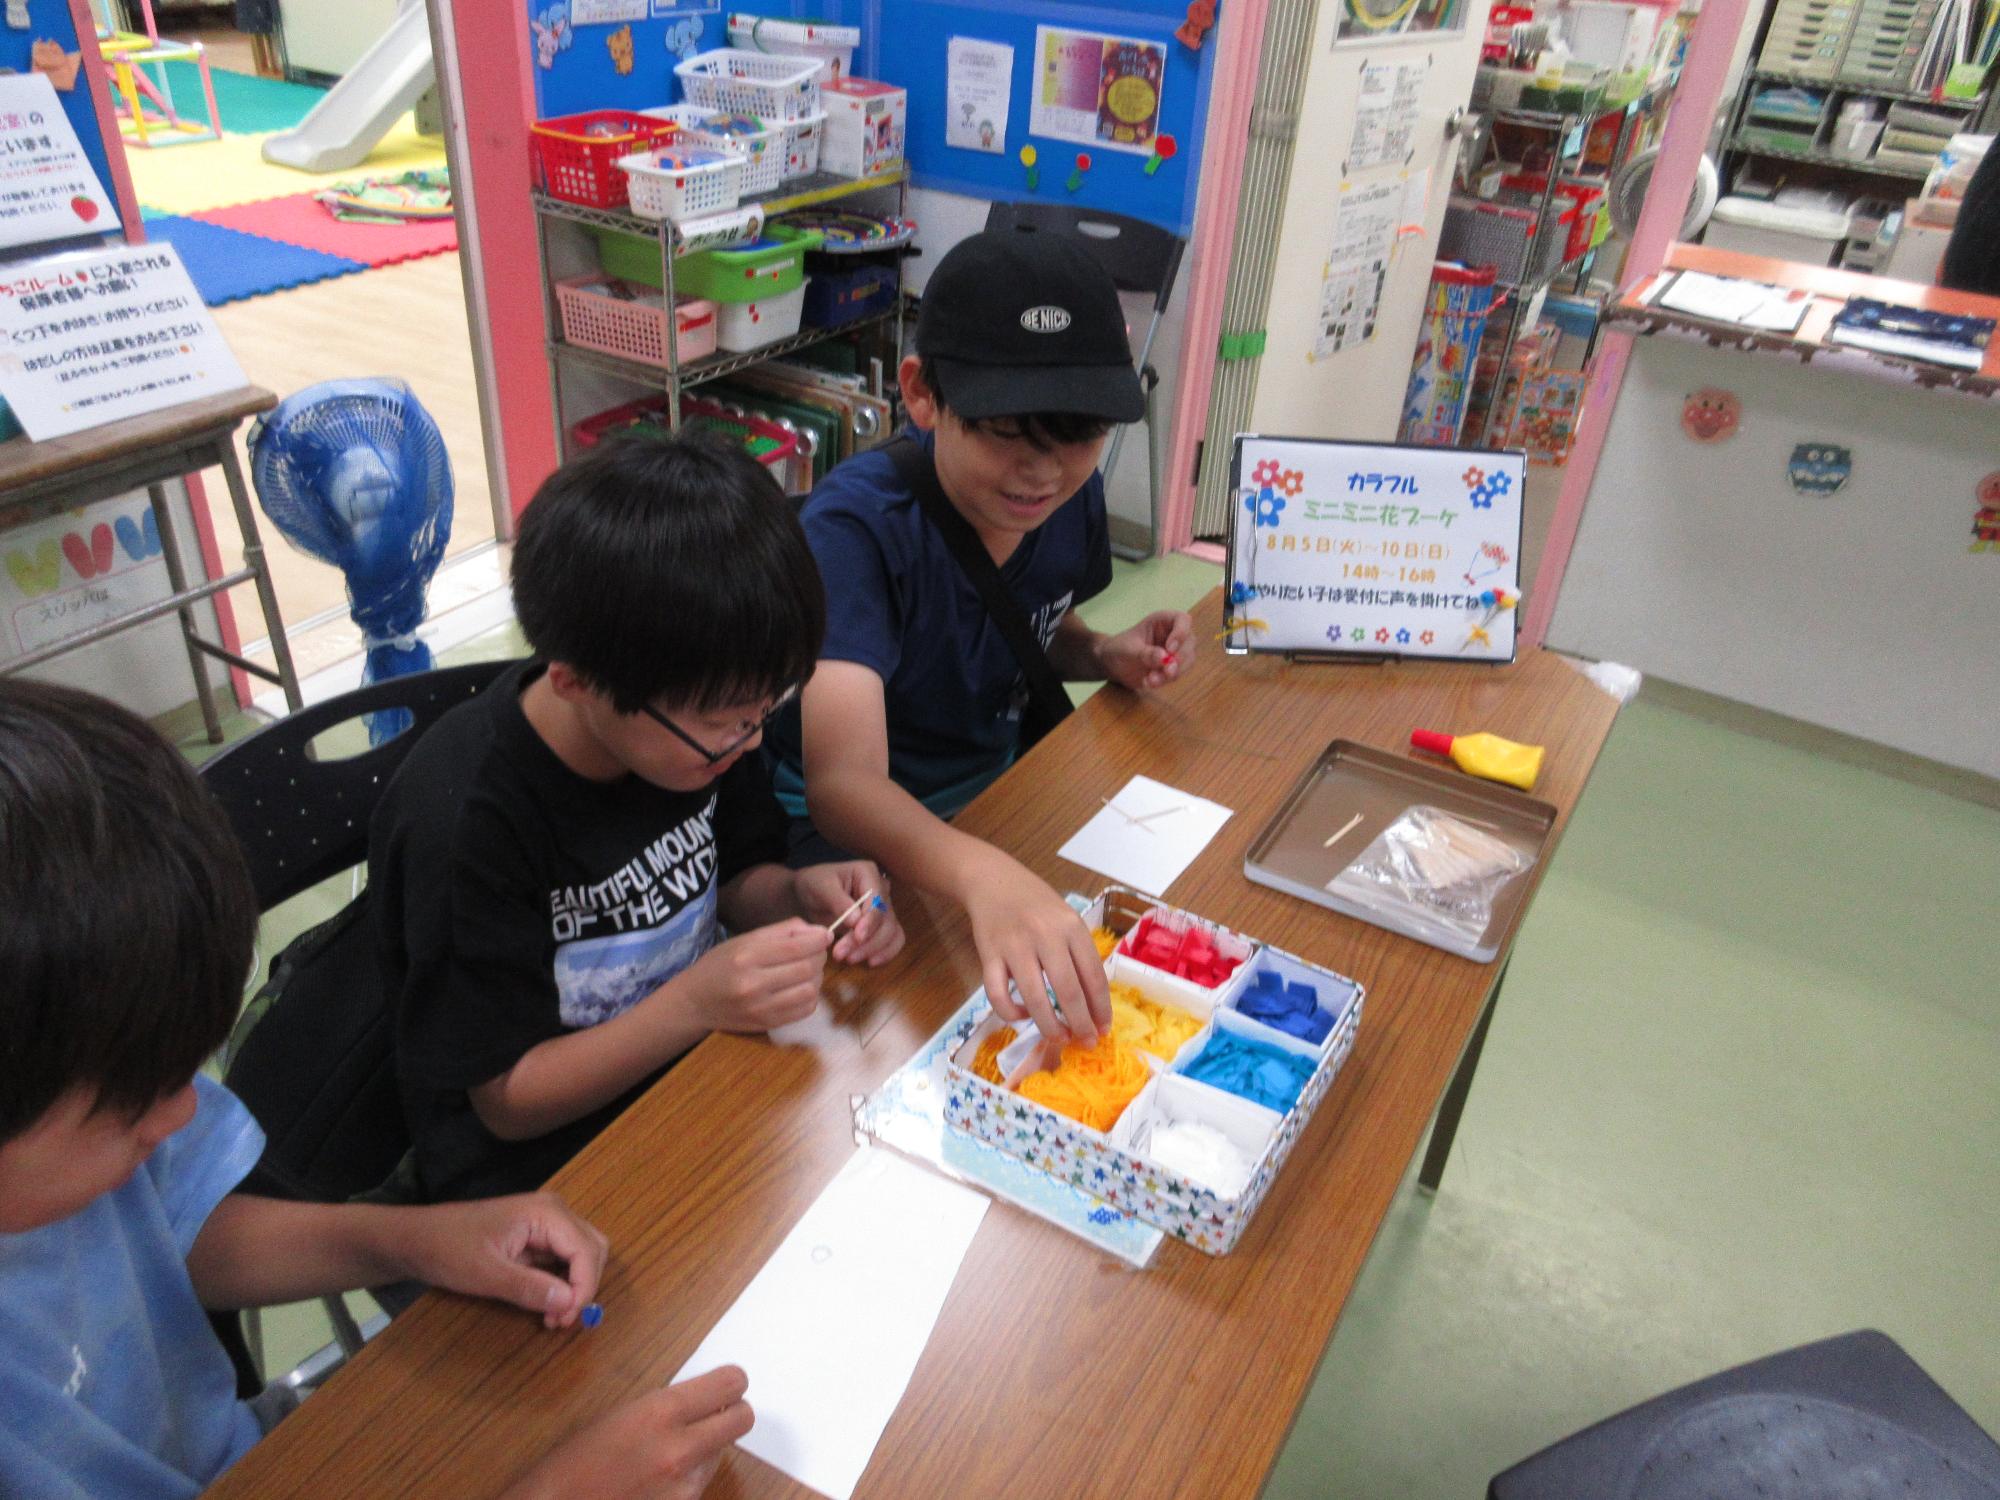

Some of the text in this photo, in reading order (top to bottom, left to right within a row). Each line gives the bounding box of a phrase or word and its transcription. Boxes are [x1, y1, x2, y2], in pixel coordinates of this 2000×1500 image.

[1347, 472, 1419, 494] カラフル
[552, 910, 598, 942] OF
[603, 884, 671, 931] THE
